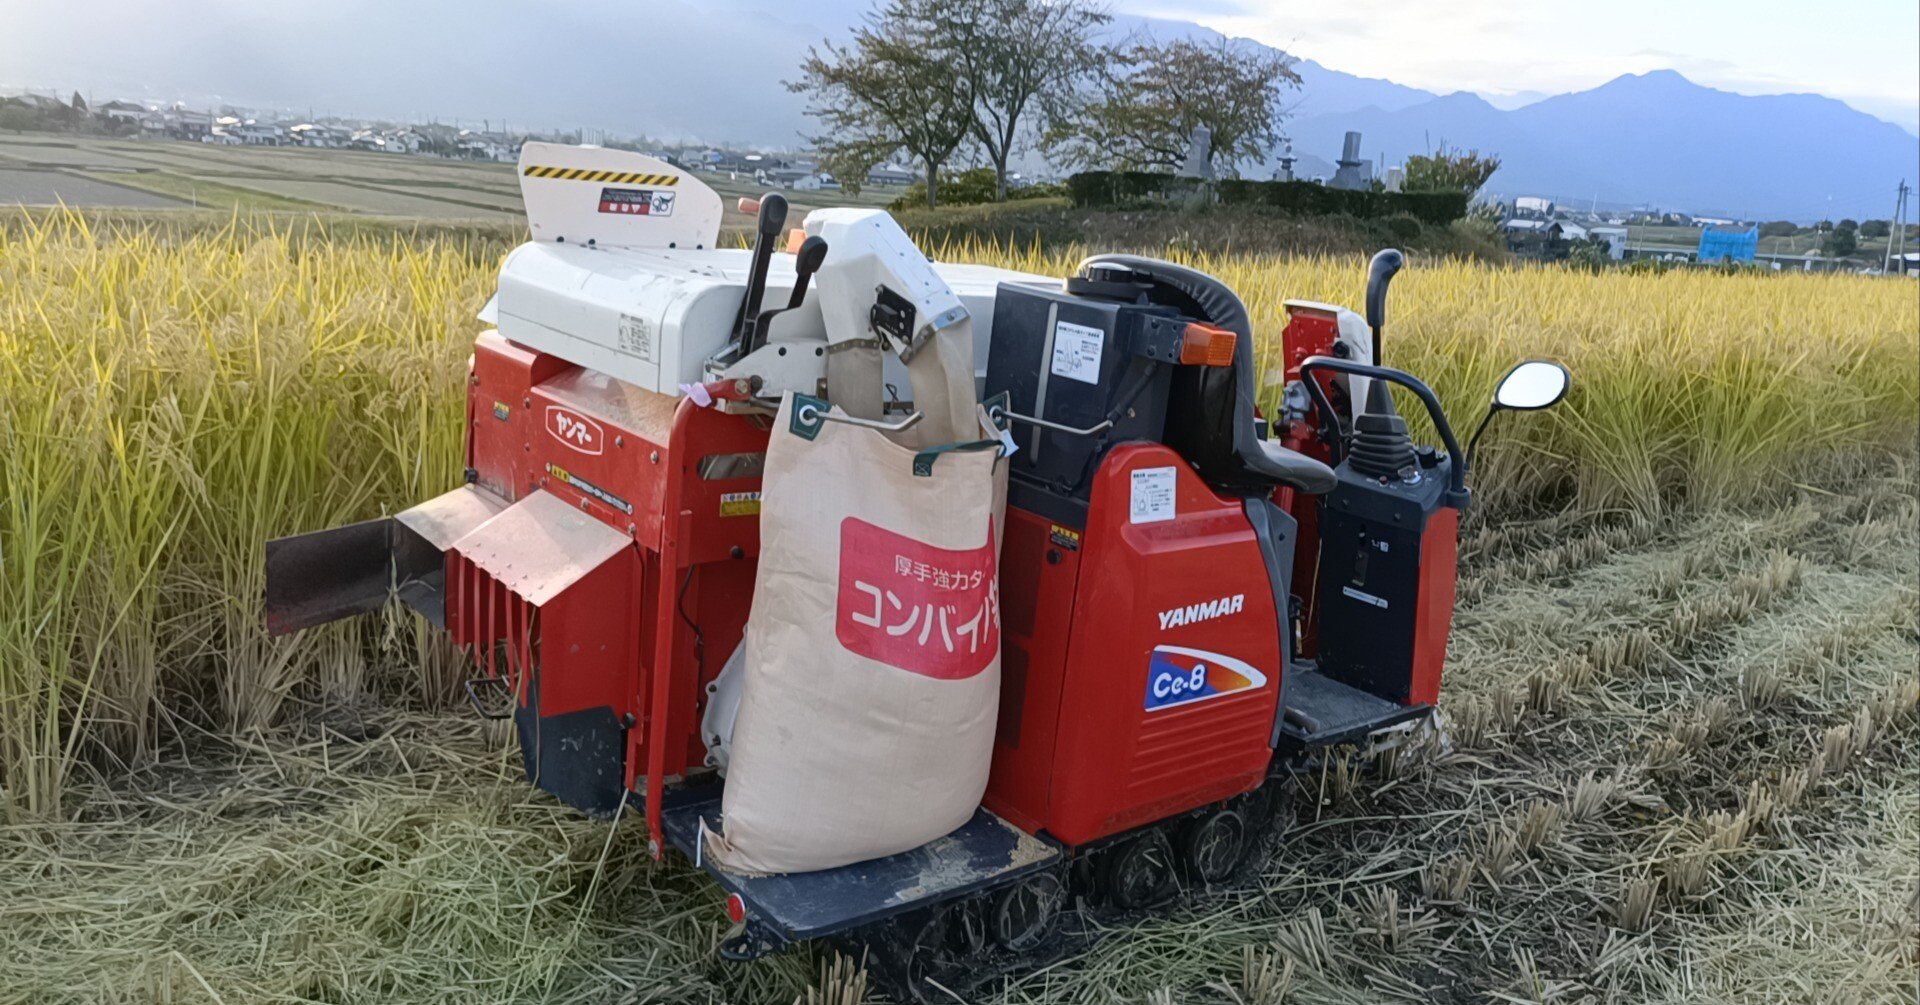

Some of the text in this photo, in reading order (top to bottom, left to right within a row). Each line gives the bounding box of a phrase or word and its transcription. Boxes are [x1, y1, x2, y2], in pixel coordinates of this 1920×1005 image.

[556, 411, 593, 445] ヤンマー
[895, 554, 986, 591] 厚手強力タ
[1157, 593, 1245, 631] YANMAR
